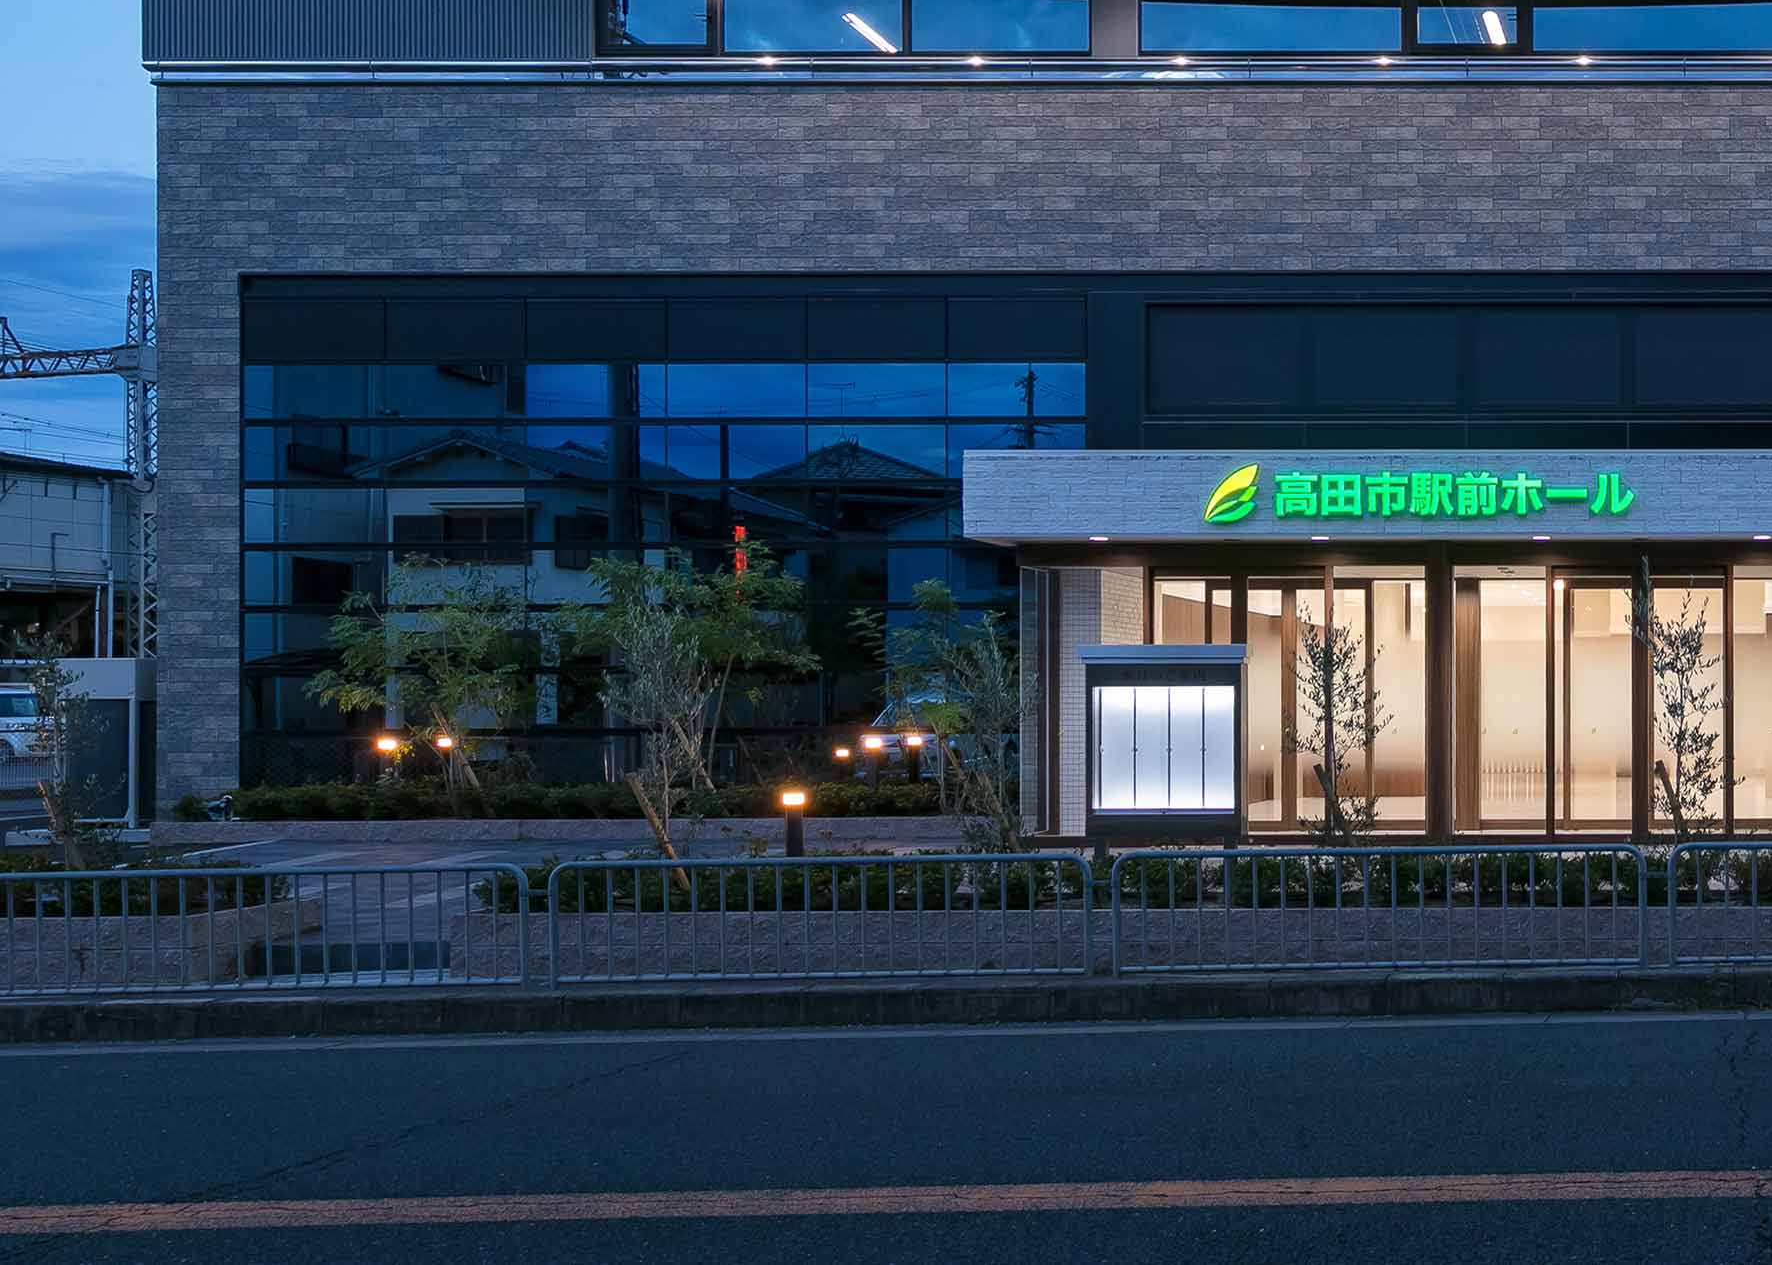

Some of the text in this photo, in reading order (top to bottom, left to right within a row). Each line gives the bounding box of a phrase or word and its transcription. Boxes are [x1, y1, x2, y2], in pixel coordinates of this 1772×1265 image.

[1274, 472, 1634, 517] 高田市駅前ホール
